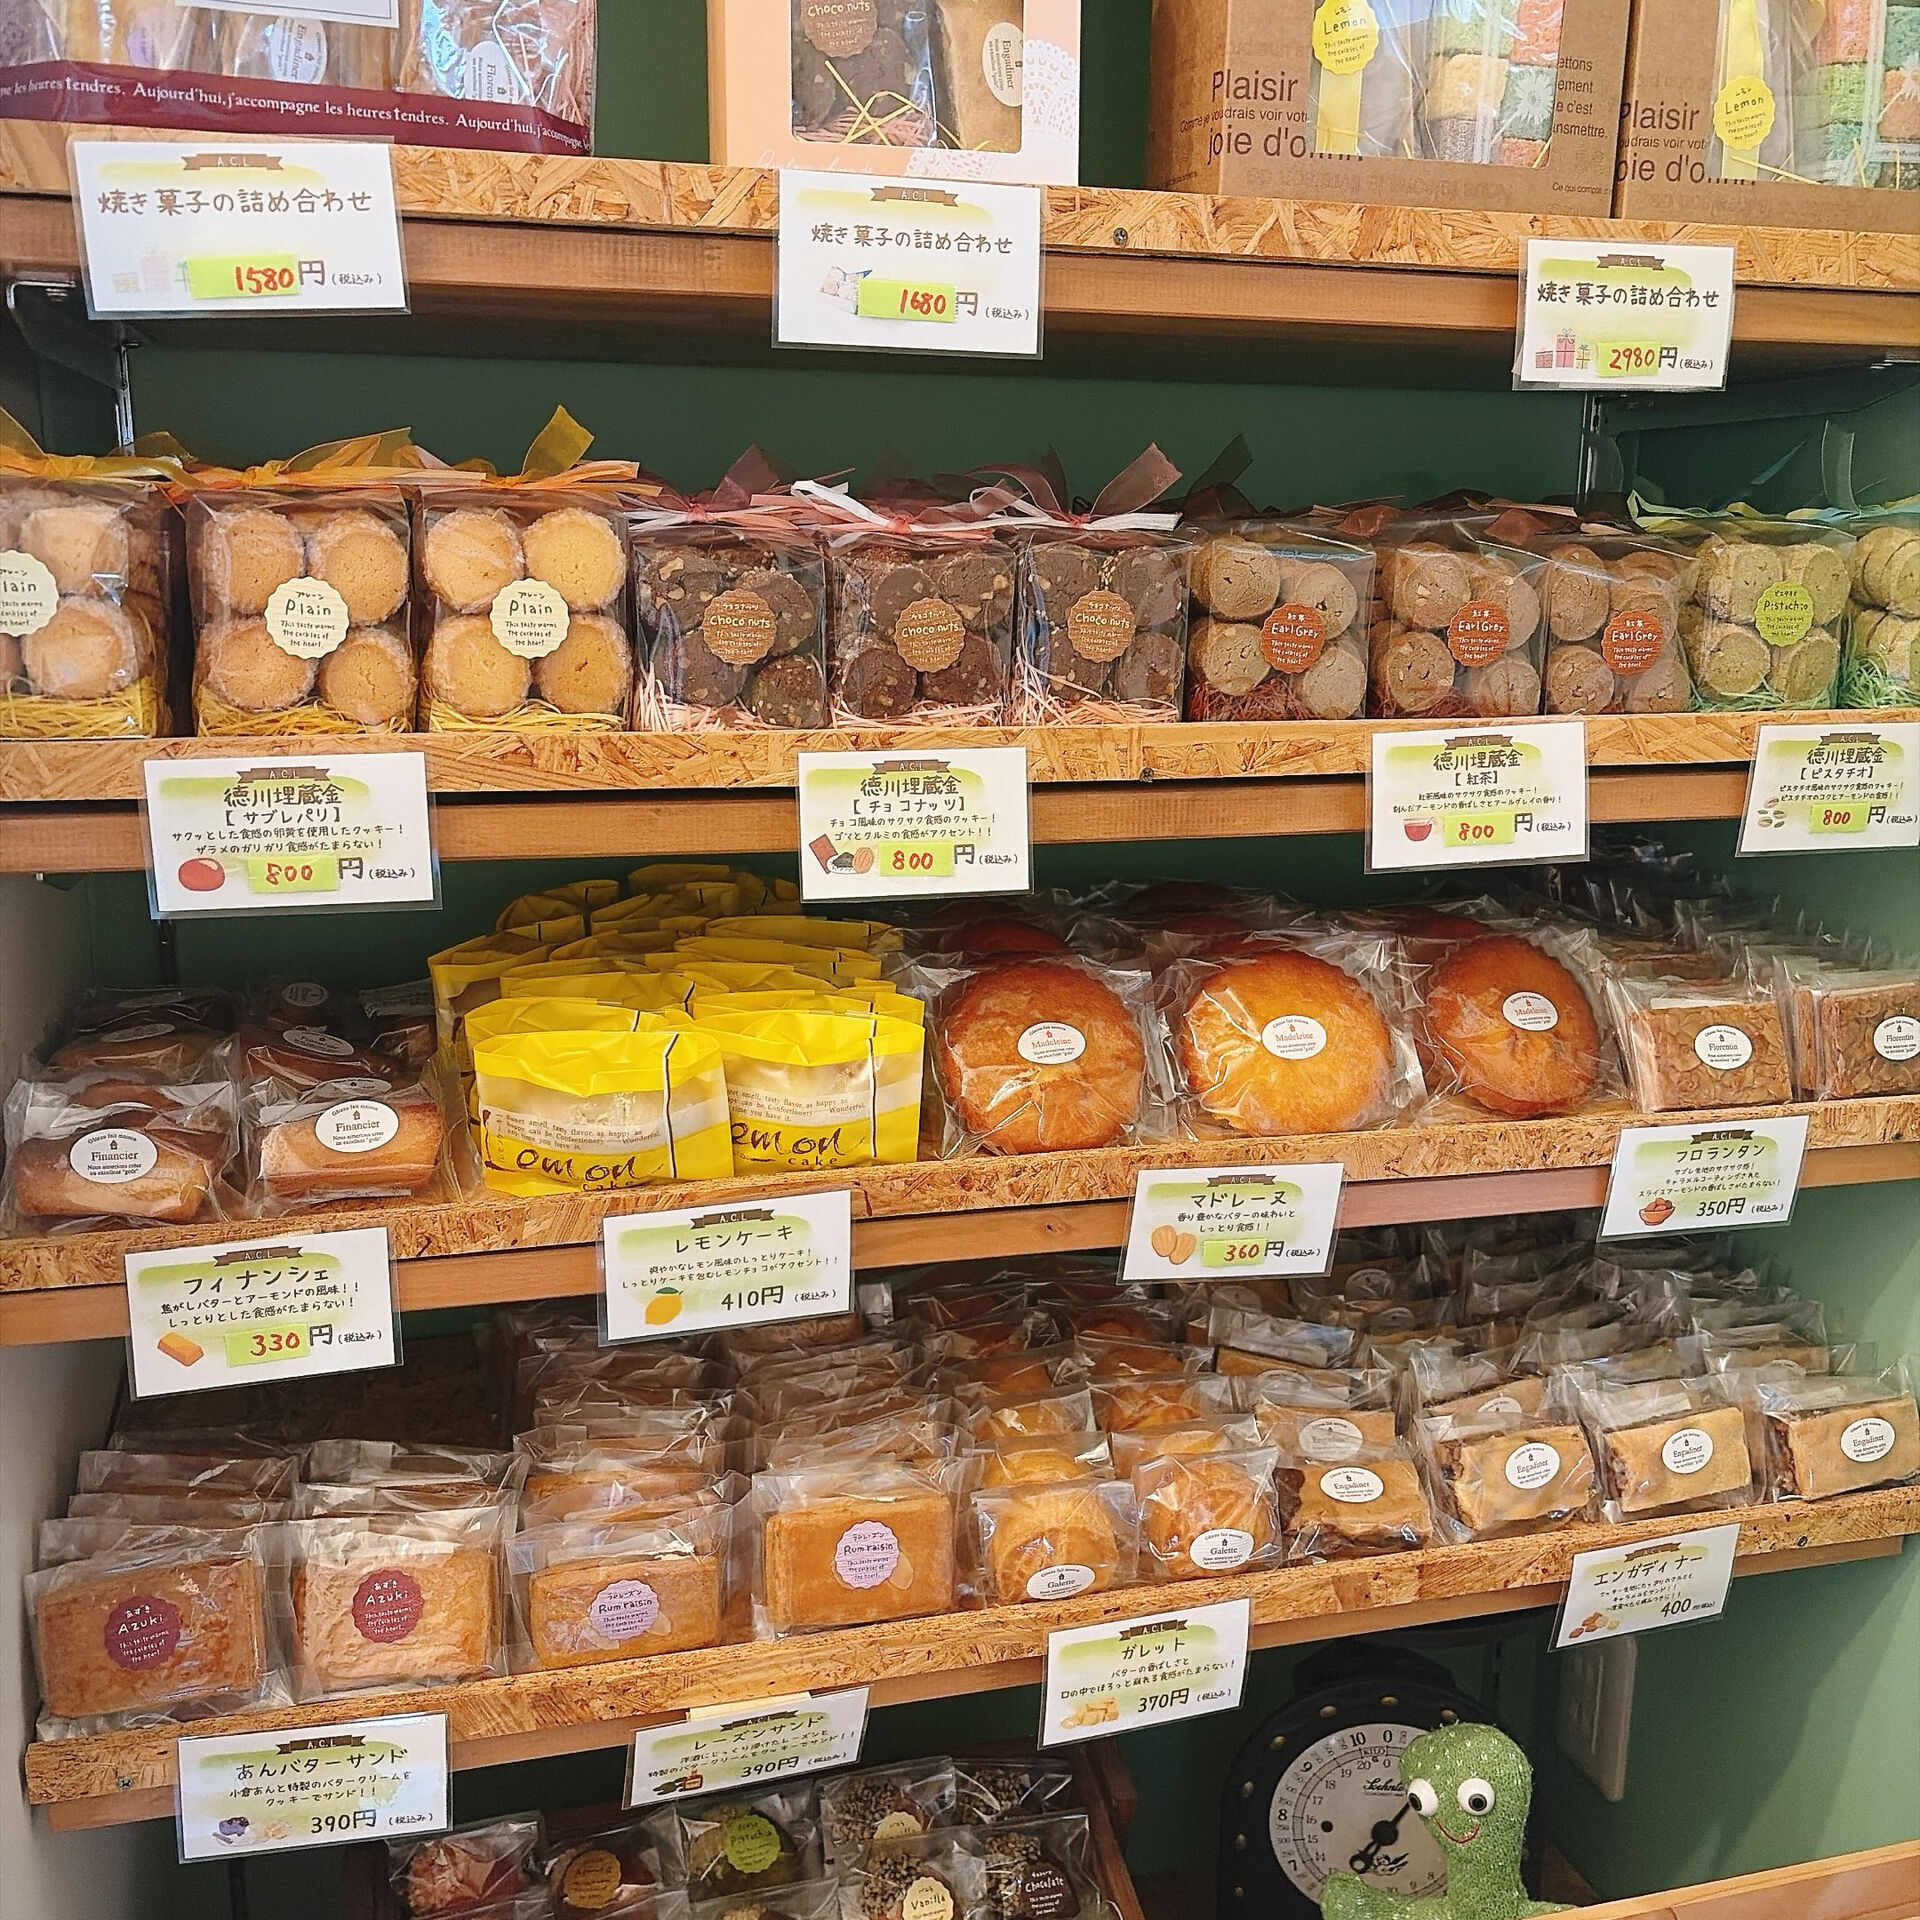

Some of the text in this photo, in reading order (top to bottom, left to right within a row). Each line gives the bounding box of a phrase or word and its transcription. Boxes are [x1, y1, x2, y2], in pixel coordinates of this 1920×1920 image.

[808, 2, 844, 17] Choco
[1323, 17, 1367, 36] Lemon
[1002, 40, 1014, 89] Engadiner
[1212, 69, 1299, 102] Plaisir
[65, 77, 125, 95] tendres.
[338, 100, 357, 113] les
[361, 103, 398, 119] heures
[394, 107, 449, 125] tendres.
[1725, 96, 1764, 115] Lemon
[1259, 110, 1283, 122] voir
[1207, 124, 1252, 165] joie
[1663, 137, 1685, 148] voir
[99, 187, 372, 216] 焼き菓子の詰め合わせ
[811, 223, 1013, 255] 焼き菓子の詰め合わせ
[1538, 281, 1719, 308] 焼き菓子の詰め合わせ
[285, 599, 331, 615] Plain
[510, 600, 552, 616] Plain
[1763, 601, 1809, 612] Pistachio
[710, 615, 770, 628] Choco nuts
[1076, 613, 1130, 628] Choco nuts
[1458, 620, 1504, 632] Earl Grey
[902, 621, 959, 637] Choco nuts
[1272, 623, 1318, 639] Earl Grey
[1612, 630, 1657, 642] Earl Grey
[1433, 749, 1523, 771] 徳川埋蔵金
[1806, 747, 1887, 765] 徳川埋蔵金
[269, 769, 300, 779] A.C.L
[860, 775, 961, 797] 徳川埋蔵金
[223, 784, 344, 808] 徳川埋蔵金
[336, 1120, 380, 1132] Financier
[91, 1151, 138, 1161] Financier
[788, 1156, 838, 1166] cake
[1676, 1145, 1765, 1163] フロランタン
[1191, 1190, 1287, 1208] マドレーヌ
[1697, 1197, 1746, 1217] 350円
[719, 1213, 748, 1224] A.C.L
[676, 1225, 793, 1254] レモンケーキ
[244, 1251, 273, 1260] A.C.L
[184, 1266, 328, 1295] フィナンシェ
[721, 1285, 784, 1311] 410円
[844, 1543, 893, 1556] Rum raisin
[1210, 1546, 1238, 1555] Galette
[1594, 1555, 1703, 1586] エンガディナー
[1047, 1577, 1076, 1589] Galette
[365, 1590, 408, 1606] Azuki
[599, 1600, 652, 1614] Rum raisin
[118, 1614, 163, 1635] Azuki
[1122, 1637, 1186, 1660] ガレット
[1137, 1688, 1190, 1713] 370円
[694, 1716, 824, 1751] レーズンサンド
[1350, 1730, 1392, 1747] 10 0
[307, 1739, 337, 1749] A.C.L
[236, 1748, 408, 1781] あんバターサンド
[1357, 1761, 1371, 1770] 20
[1340, 1768, 1352, 1778] 19
[1325, 1780, 1336, 1789] 18
[1312, 1796, 1323, 1805] 17
[310, 1809, 376, 1834] 390円
[1278, 1808, 1288, 1820] 8
[1025, 1877, 1064, 1893] Chocolate
[911, 1895, 946, 1911] Vanilla
